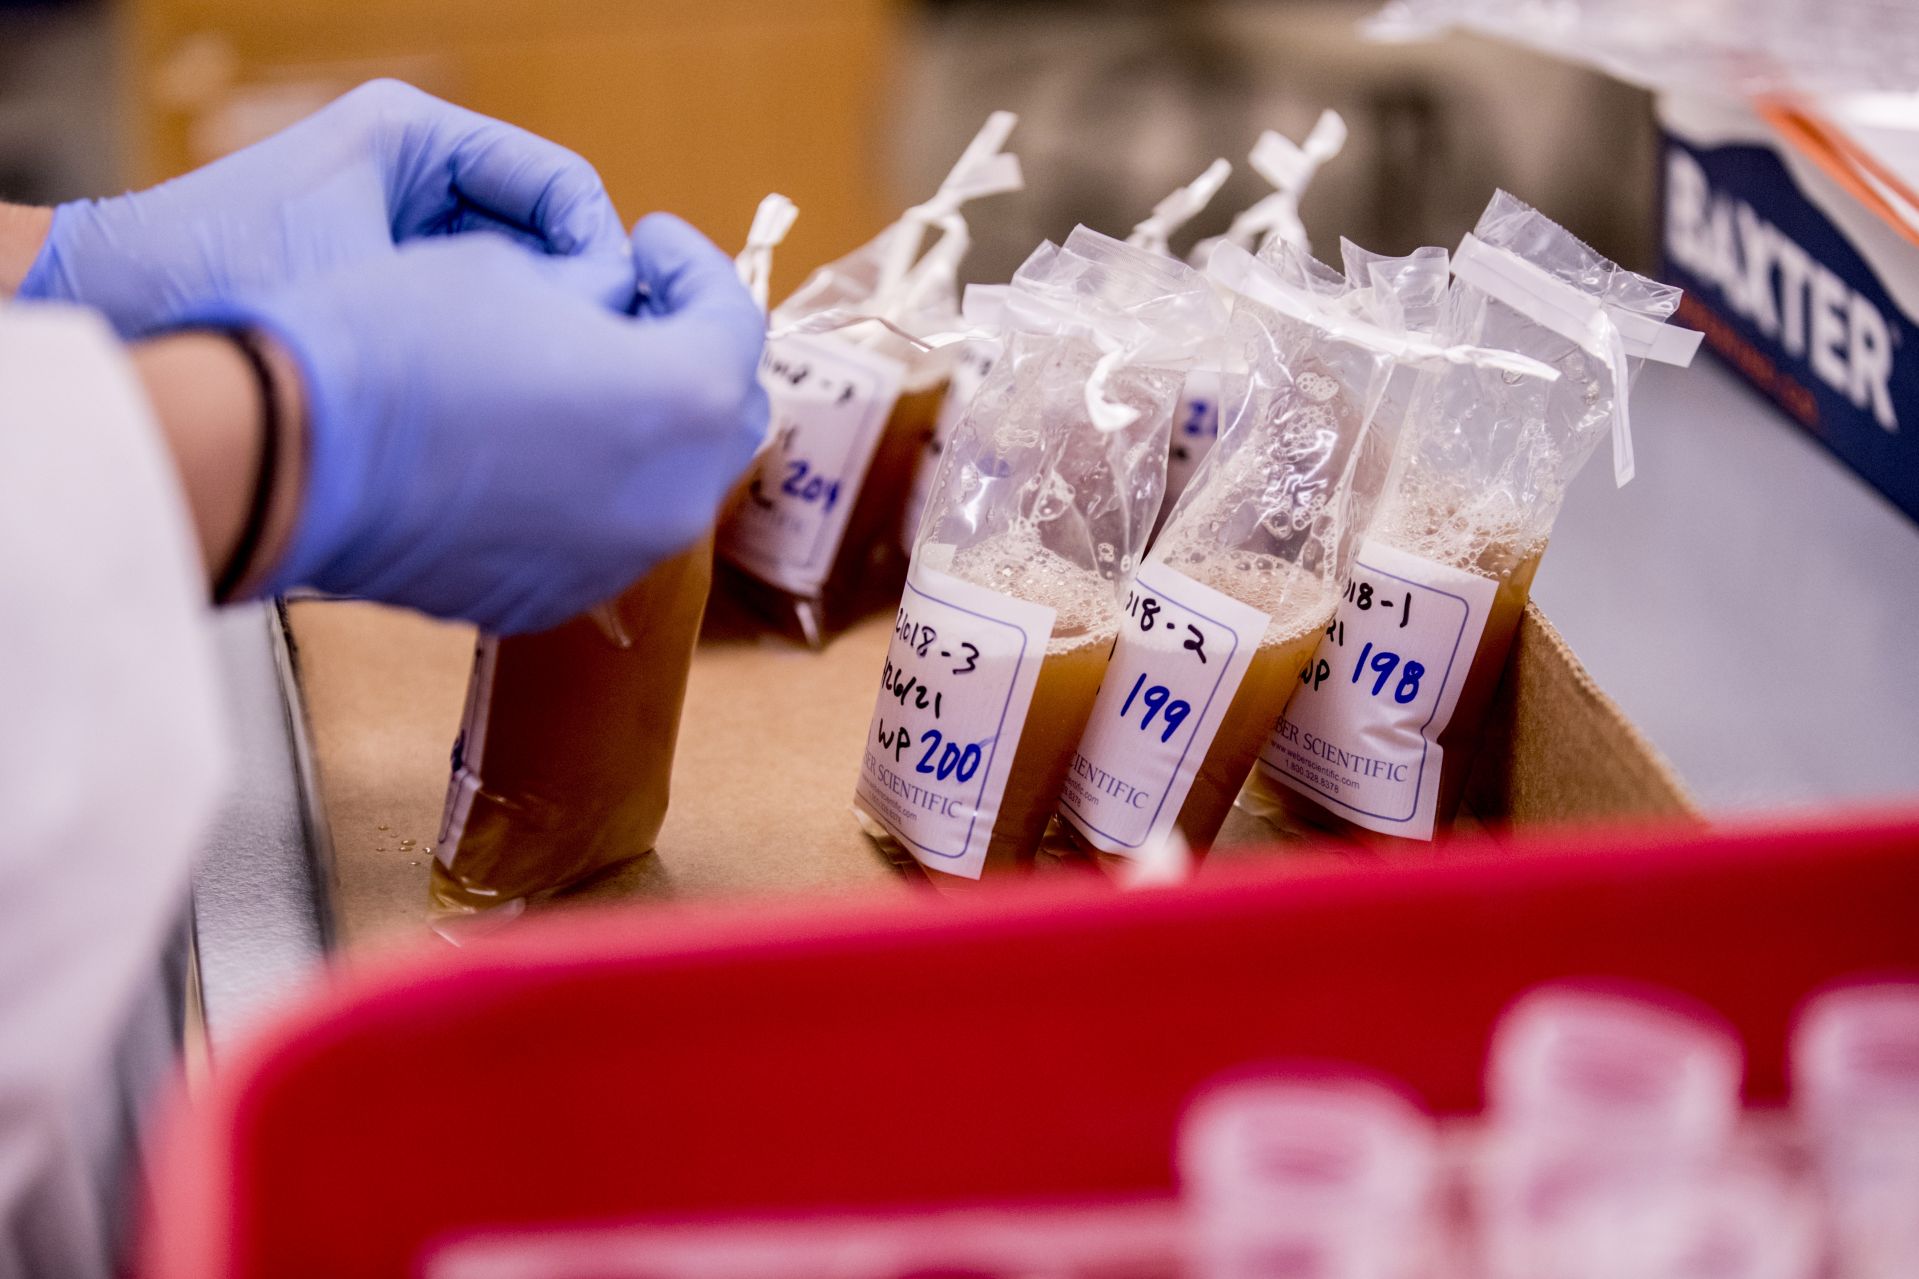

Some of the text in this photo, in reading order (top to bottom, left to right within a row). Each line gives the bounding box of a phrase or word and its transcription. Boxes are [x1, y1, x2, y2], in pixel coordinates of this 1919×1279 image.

[1667, 147, 1899, 432] BAXTER
[1351, 641, 1425, 704] 198
[1120, 672, 1191, 743] 199
[915, 729, 982, 783] 200
[1302, 732, 1409, 783] SCIENTIFIC
[877, 763, 963, 819] SCIENTIFIC
